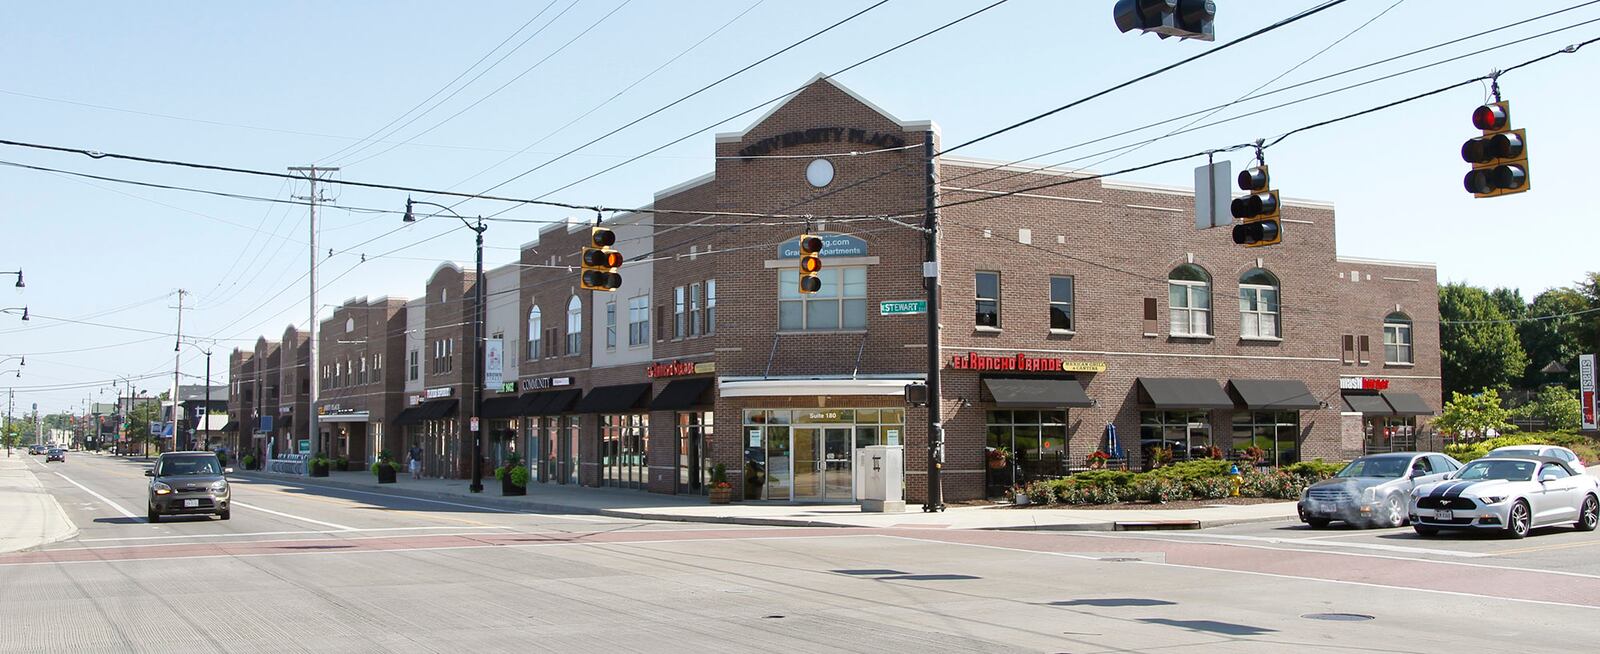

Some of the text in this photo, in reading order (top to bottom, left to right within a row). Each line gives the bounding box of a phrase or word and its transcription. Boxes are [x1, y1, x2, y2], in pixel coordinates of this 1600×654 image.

[738, 127, 906, 159] UNIVERSITY PLACE
[819, 247, 861, 257] Apartments
[885, 302, 918, 312] STEWART
[954, 352, 1062, 371] EL RANCHO GRANDE
[522, 377, 550, 391] COMMUNITY
